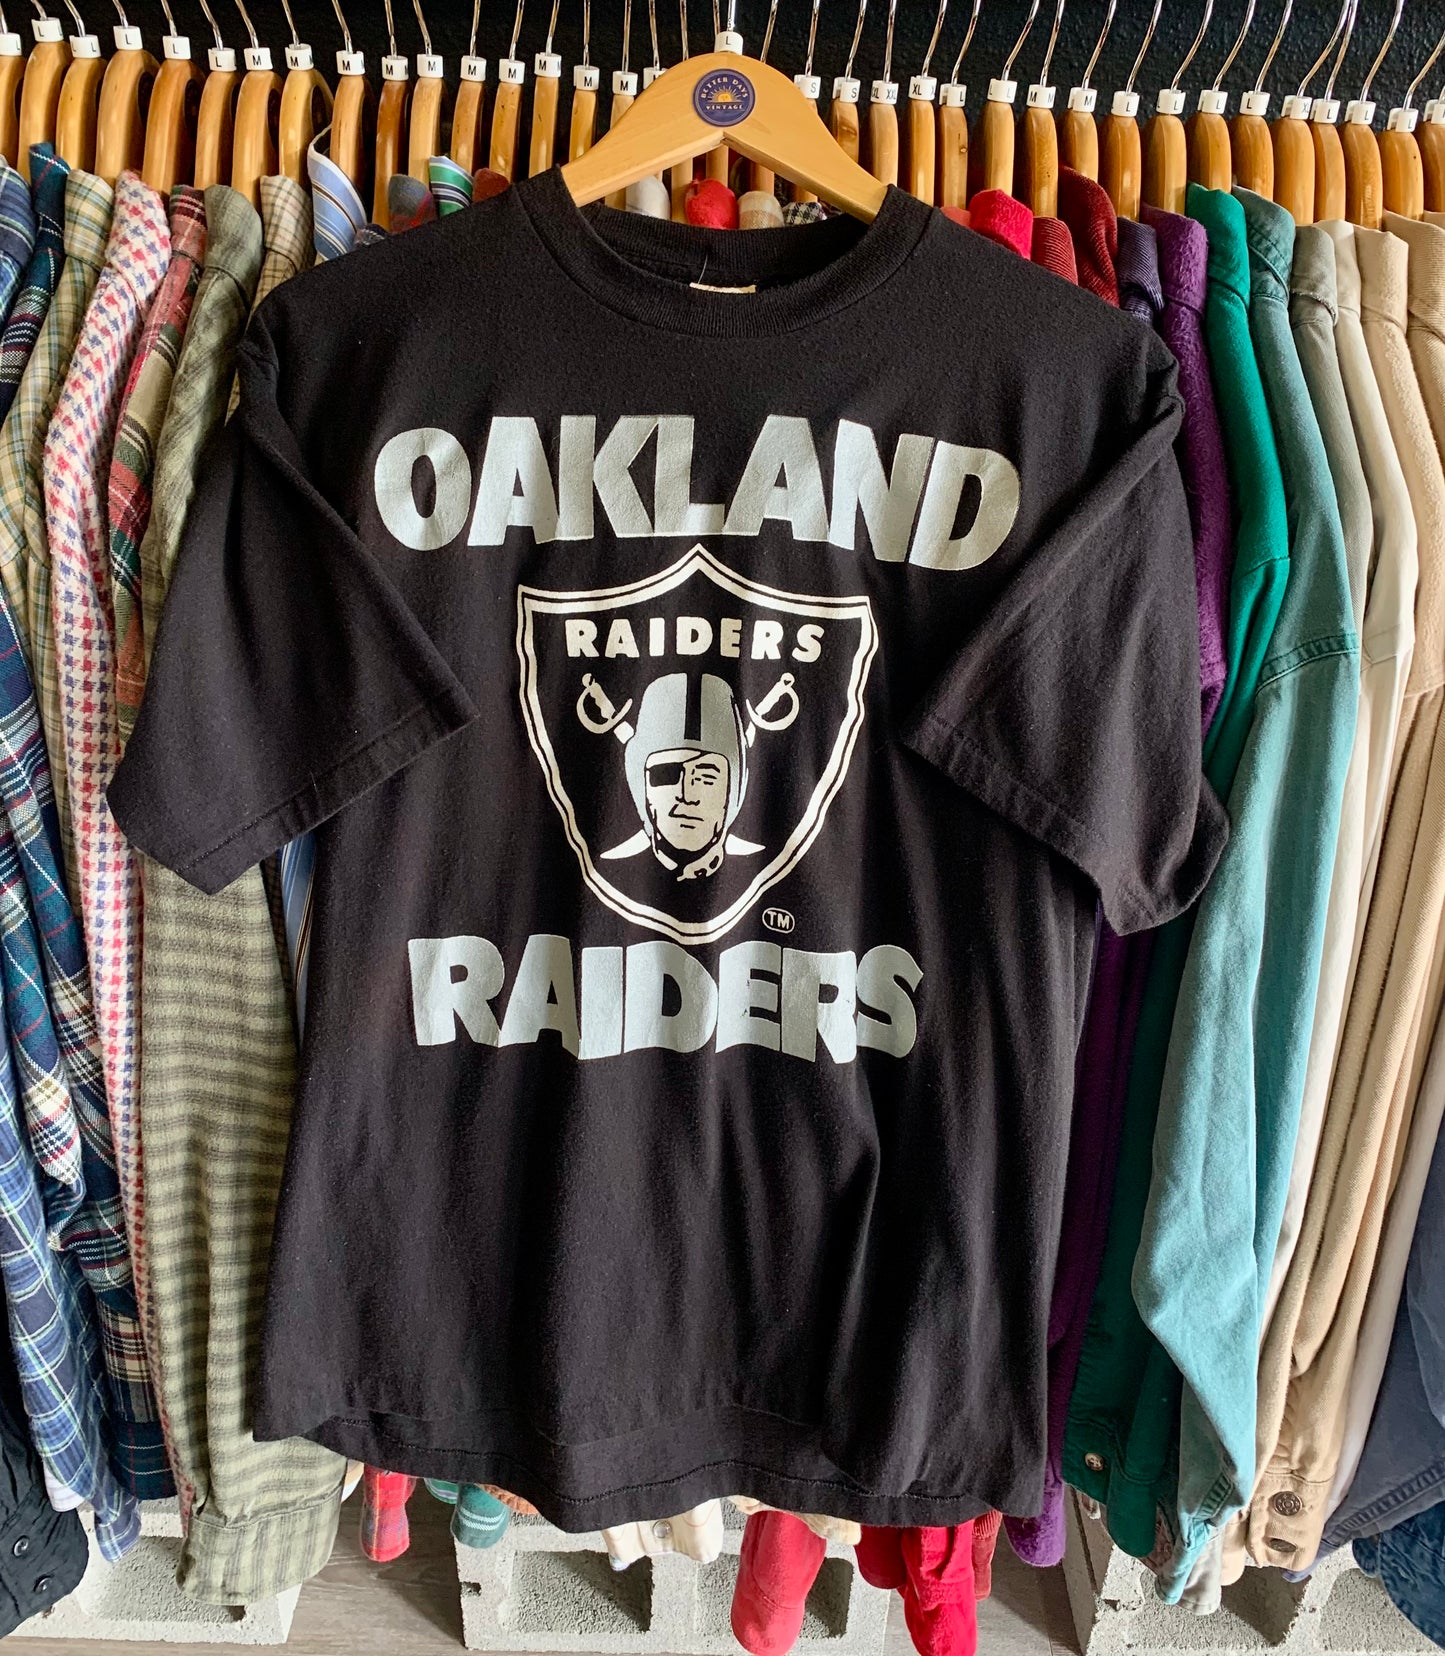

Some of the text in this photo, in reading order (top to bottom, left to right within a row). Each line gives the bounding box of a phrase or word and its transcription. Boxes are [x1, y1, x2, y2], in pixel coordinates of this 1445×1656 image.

[38, 26, 44, 37] L
[125, 34, 132, 44] L
[725, 36, 731, 45] L
[91, 42, 97, 52] L
[172, 43, 179, 54] L
[215, 56, 222, 67] L
[252, 55, 262, 66] M
[290, 56, 299, 67] M
[342, 60, 351, 71] M
[427, 60, 437, 71] M
[538, 59, 547, 71] M
[385, 64, 394, 75] M
[468, 64, 477, 75] M
[508, 68, 517, 79] M
[583, 76, 593, 87] M
[619, 80, 629, 91] M
[732, 79, 748, 98] DAYS
[810, 82, 817, 94] S
[851, 88, 858, 99] S
[912, 84, 922, 96] XL
[959, 91, 965, 102] L
[1029, 91, 1038, 103] M
[1084, 95, 1093, 106] M
[1126, 101, 1132, 112] L
[1246, 98, 1253, 109] L
[1326, 108, 1333, 120] L
[374, 415, 1021, 571] OAKLAND
[564, 616, 826, 663] RAIDERS
[767, 910, 790, 930] TM
[407, 933, 925, 1064] RAIDERS
